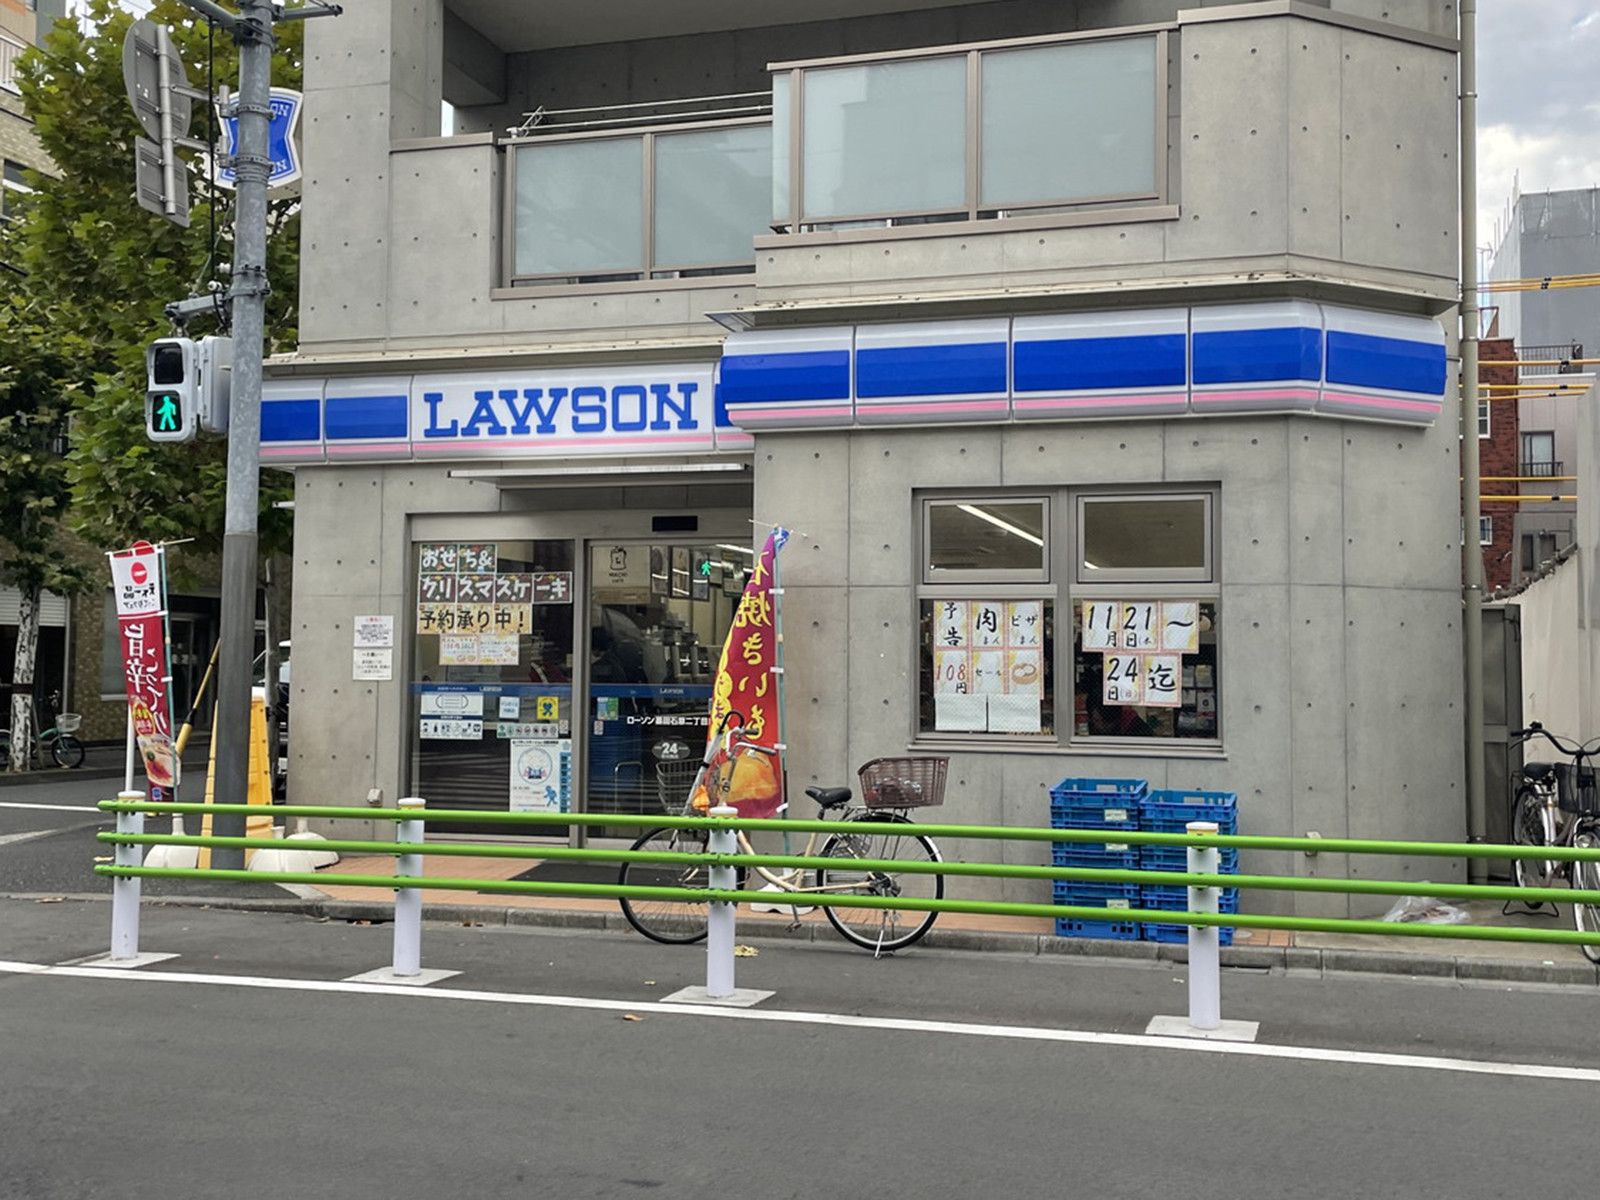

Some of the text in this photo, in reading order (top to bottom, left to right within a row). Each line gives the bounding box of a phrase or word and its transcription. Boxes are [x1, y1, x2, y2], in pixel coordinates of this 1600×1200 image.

[423, 382, 698, 438] LAWSON
[422, 546, 492, 568] おせち&
[422, 577, 567, 599] クリスマスケーキ
[1148, 664, 1177, 692] 迄
[662, 742, 679, 754] 24
